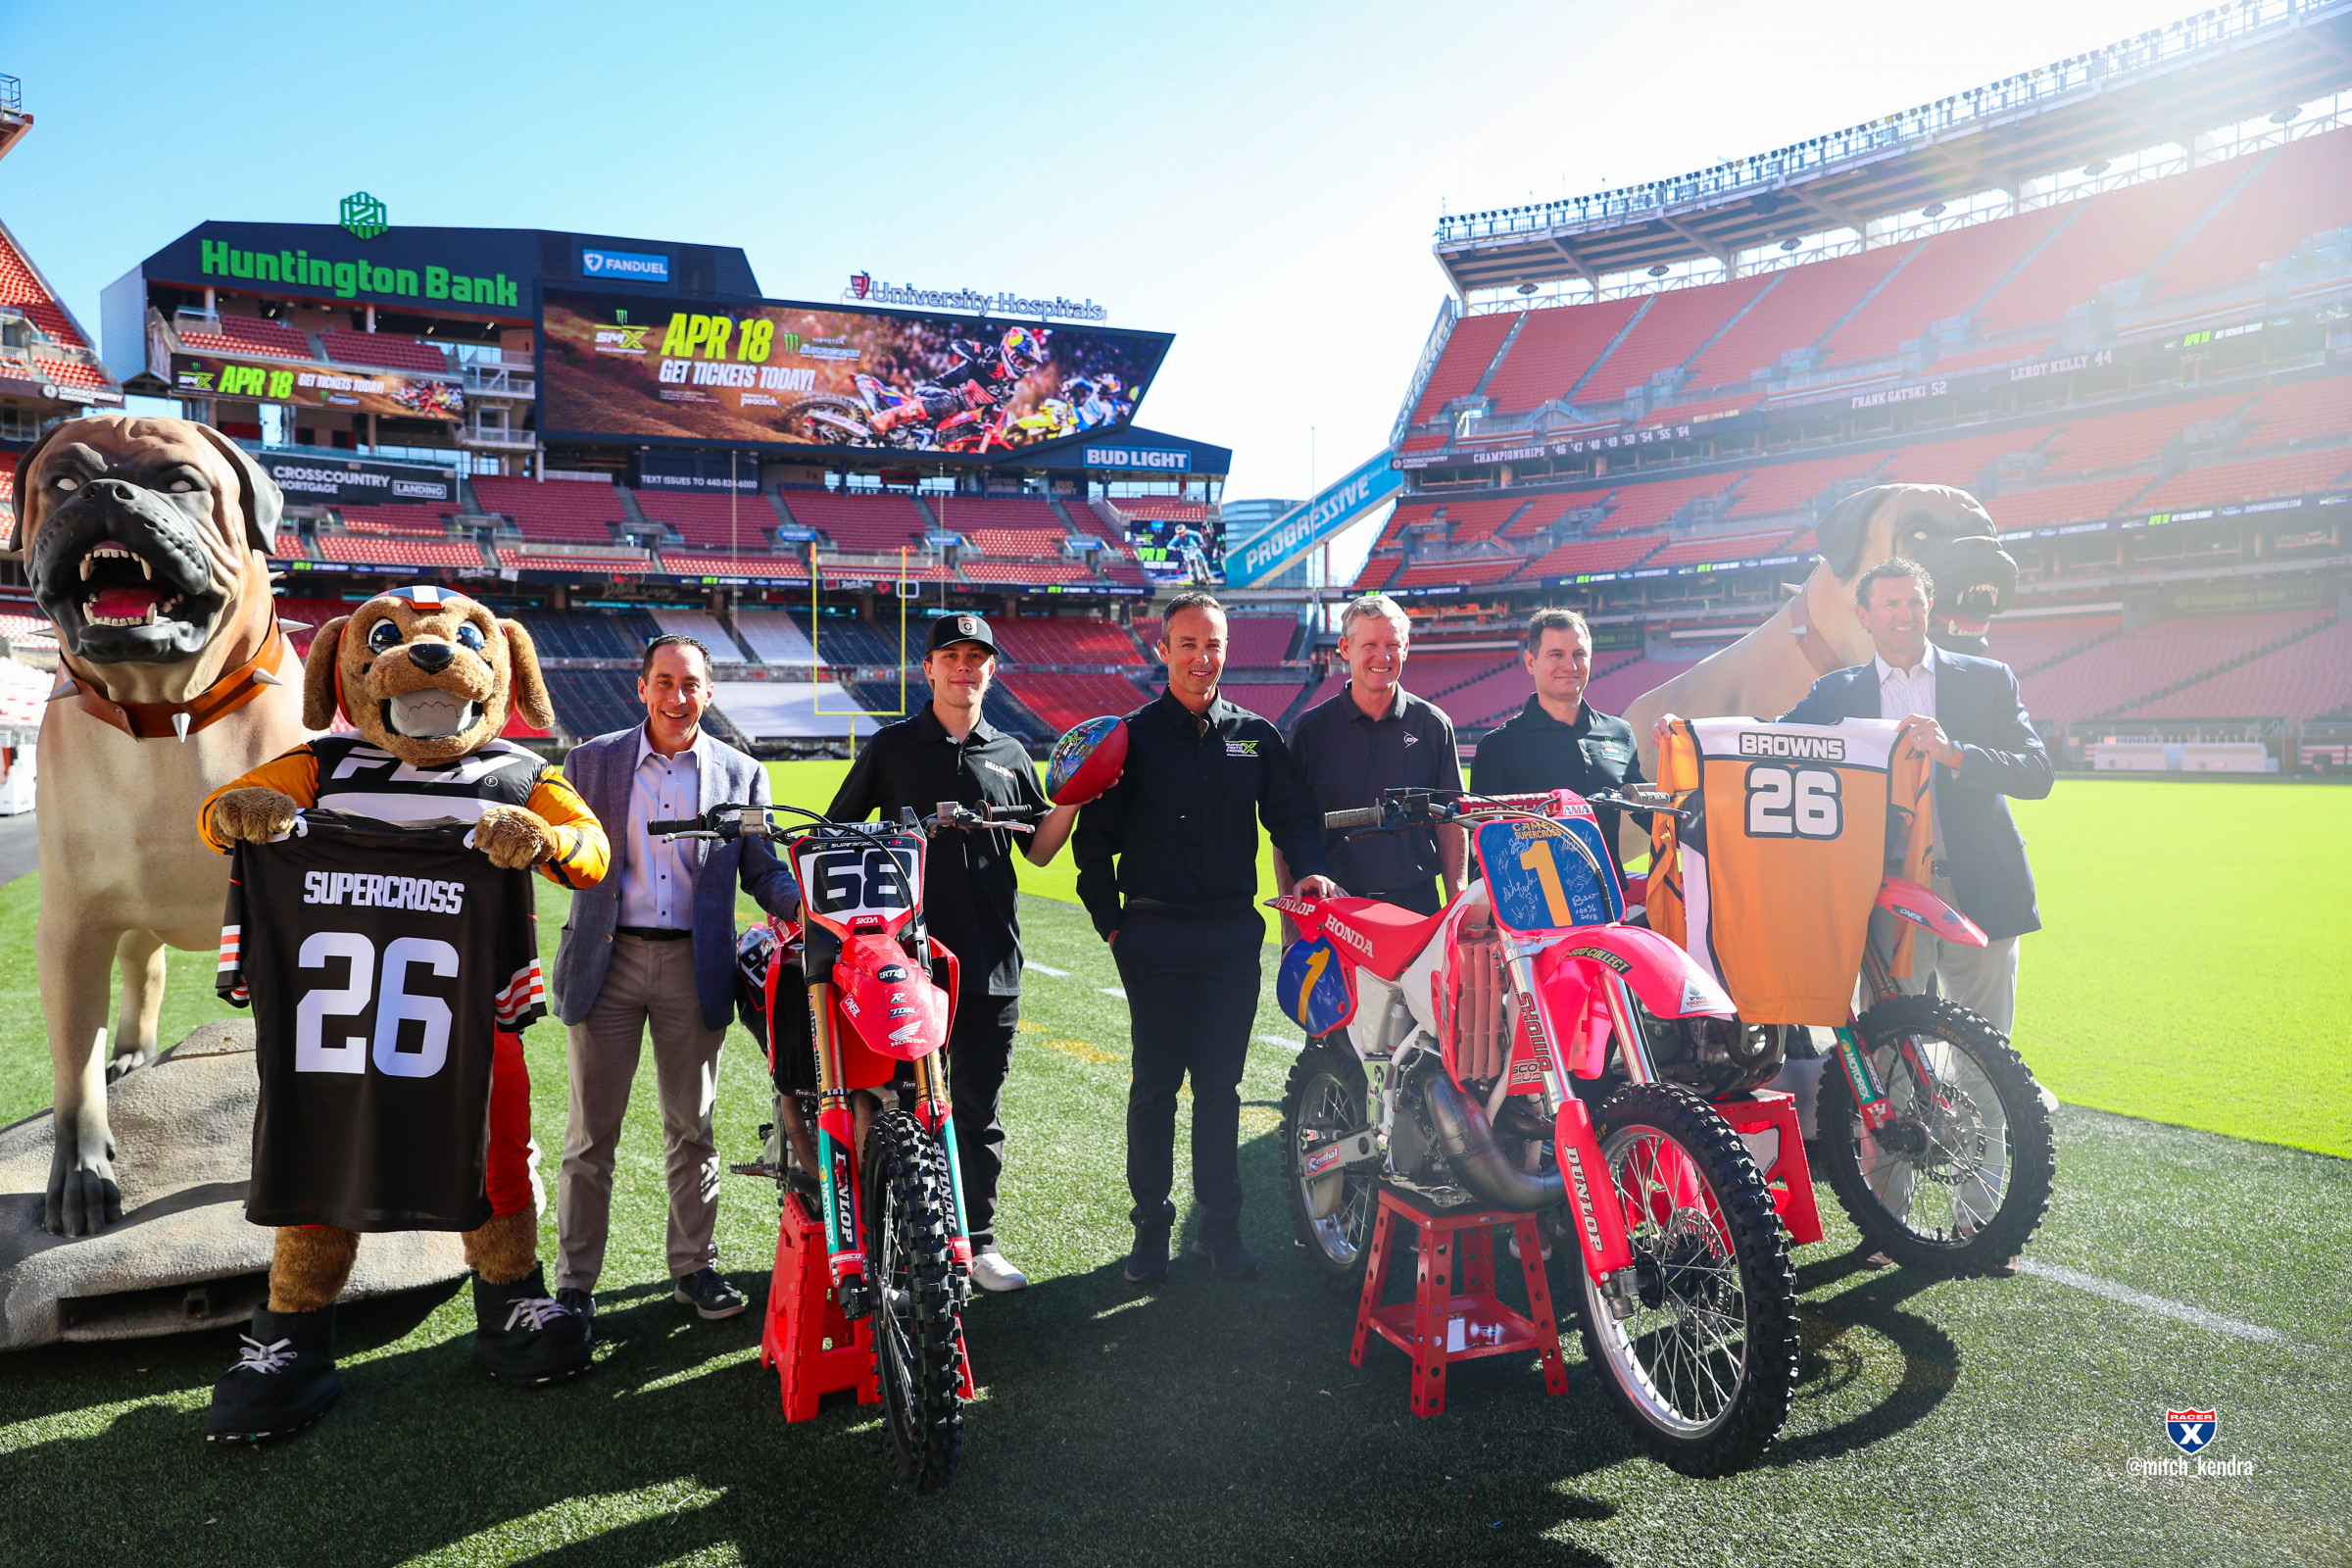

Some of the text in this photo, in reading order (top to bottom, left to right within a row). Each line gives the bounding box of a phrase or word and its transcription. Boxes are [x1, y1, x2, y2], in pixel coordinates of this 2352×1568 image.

[201, 239, 518, 307] Huntington Bank
[606, 259, 667, 274] FANDUEL
[872, 281, 1102, 321] University Hospitals
[660, 313, 775, 364] APR 18
[2183, 333, 2200, 347] APR
[2201, 330, 2211, 343] 18
[659, 360, 816, 391] GET TICKETS TODAY!
[2010, 350, 2113, 381] LEROY KELLY 44
[218, 365, 385, 399] APR 18 GET TICKETS TODAY!
[1851, 380, 1947, 409] FRANK GATSKI 52
[740, 396, 778, 408] peacock
[1087, 449, 1188, 468] BUD LIGHT
[1473, 447, 1545, 464] CHAMPIONSHIPS
[1552, 445, 1566, 456] '46
[1570, 442, 1584, 454] '47
[1604, 436, 1618, 448] '49
[1622, 434, 1635, 445] '50
[1639, 431, 1652, 443] '54
[1656, 428, 1671, 440] '55
[1676, 425, 1690, 437] '64
[272, 466, 391, 487] CROSSCOUNTRY
[275, 479, 444, 497] MORTGAGE LANDING
[641, 474, 662, 484] TEXT
[663, 475, 692, 486] ISSUES
[693, 477, 705, 486] TO
[1246, 474, 1370, 574] PROGRESSIVE
[2191, 592, 2254, 606] Huntington
[2256, 588, 2286, 601] Bank
[1740, 733, 1845, 761] BROWNS
[1563, 806, 1590, 815] AMA
[1746, 764, 1841, 839] 26
[1512, 822, 1556, 831] CAME
[1514, 829, 1562, 840] SUPERCROSS
[303, 870, 466, 914] SUPERCROSS
[812, 851, 912, 914] 68
[1519, 840, 1573, 927] 1
[856, 916, 878, 925] SKDA
[1325, 913, 1374, 958] HONDA
[1298, 947, 1331, 1025] 1
[295, 931, 460, 1078] 26
[890, 1006, 917, 1016] TDR
[891, 1039, 927, 1048] HONDA
[1516, 992, 1553, 1072] SHOWA
[1512, 1063, 1538, 1074] SCO
[1845, 1053, 1871, 1101] MOTOREX
[835, 1152, 854, 1243] DNLOP
[933, 1142, 957, 1233] DUNLOP
[1564, 1146, 1604, 1252] DUNLOP
[821, 1184, 834, 1247] MOTOREX
